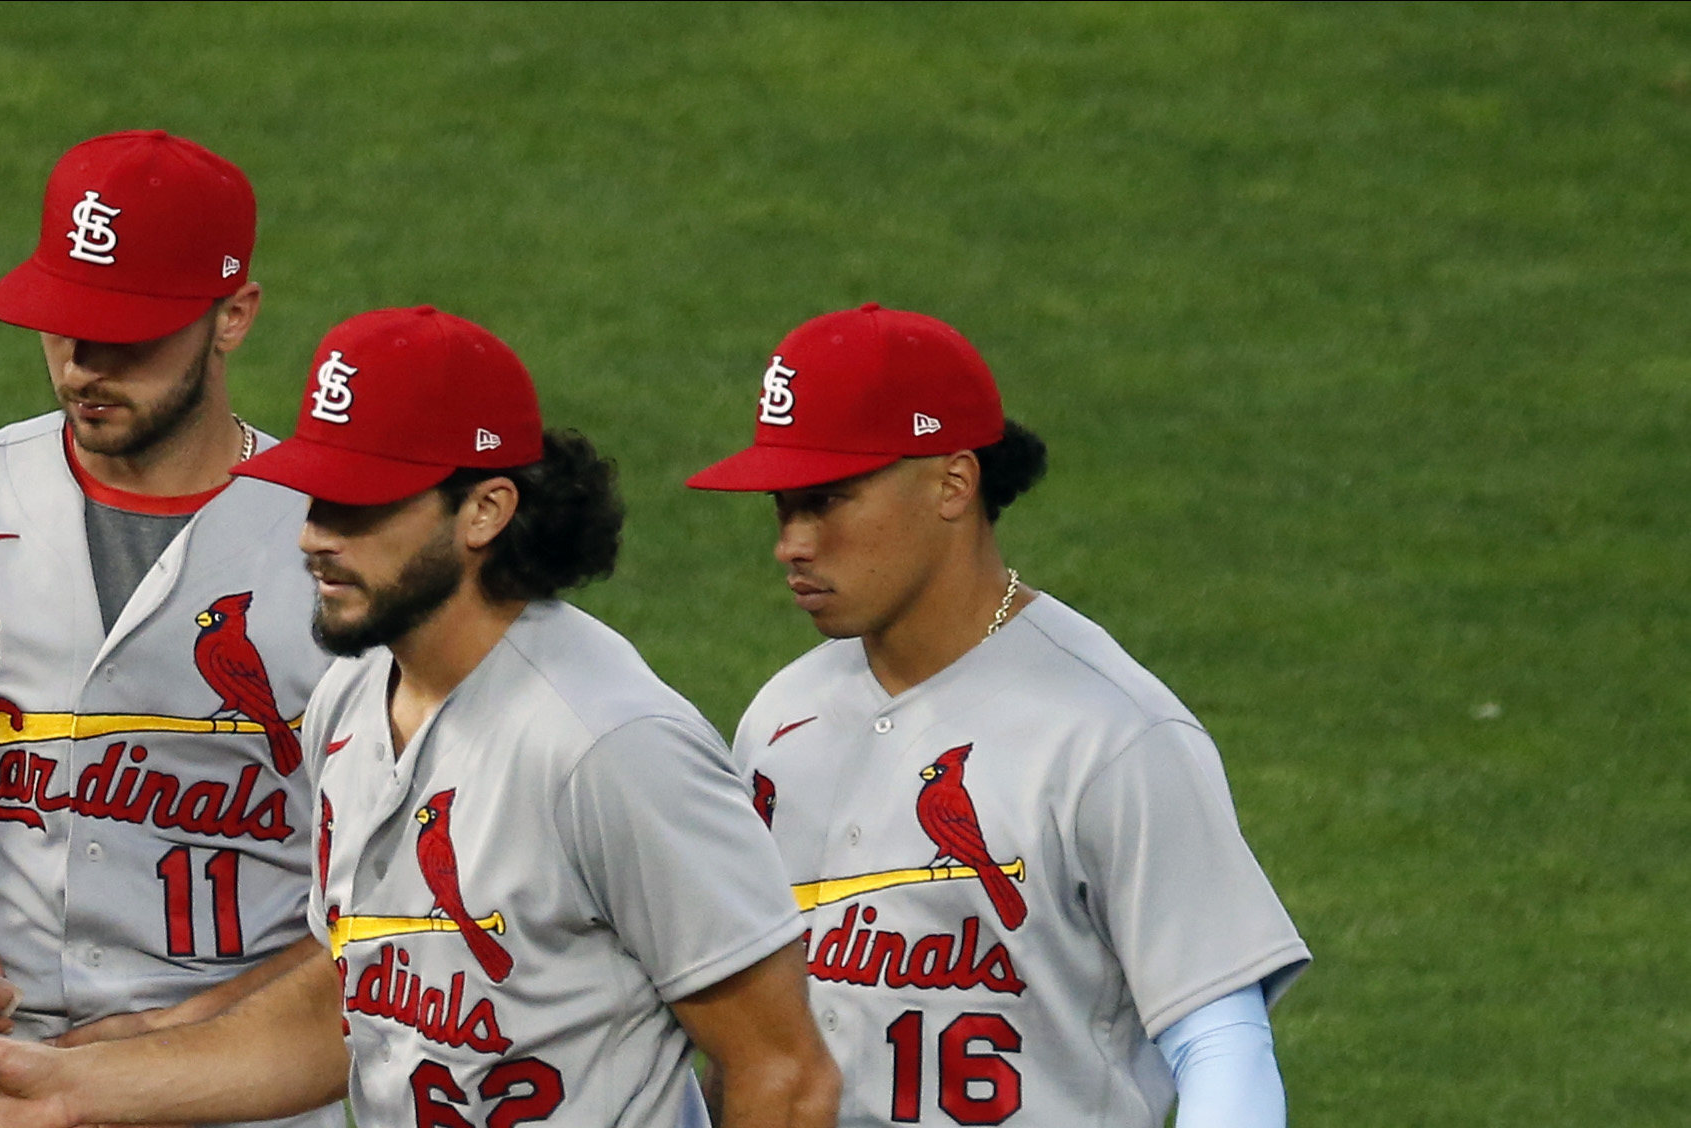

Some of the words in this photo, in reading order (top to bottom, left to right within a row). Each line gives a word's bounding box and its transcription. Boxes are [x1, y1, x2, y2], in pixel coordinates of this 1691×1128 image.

[156, 845, 244, 959] 11
[806, 903, 1028, 999] dinals
[885, 1011, 1024, 1128] 16
